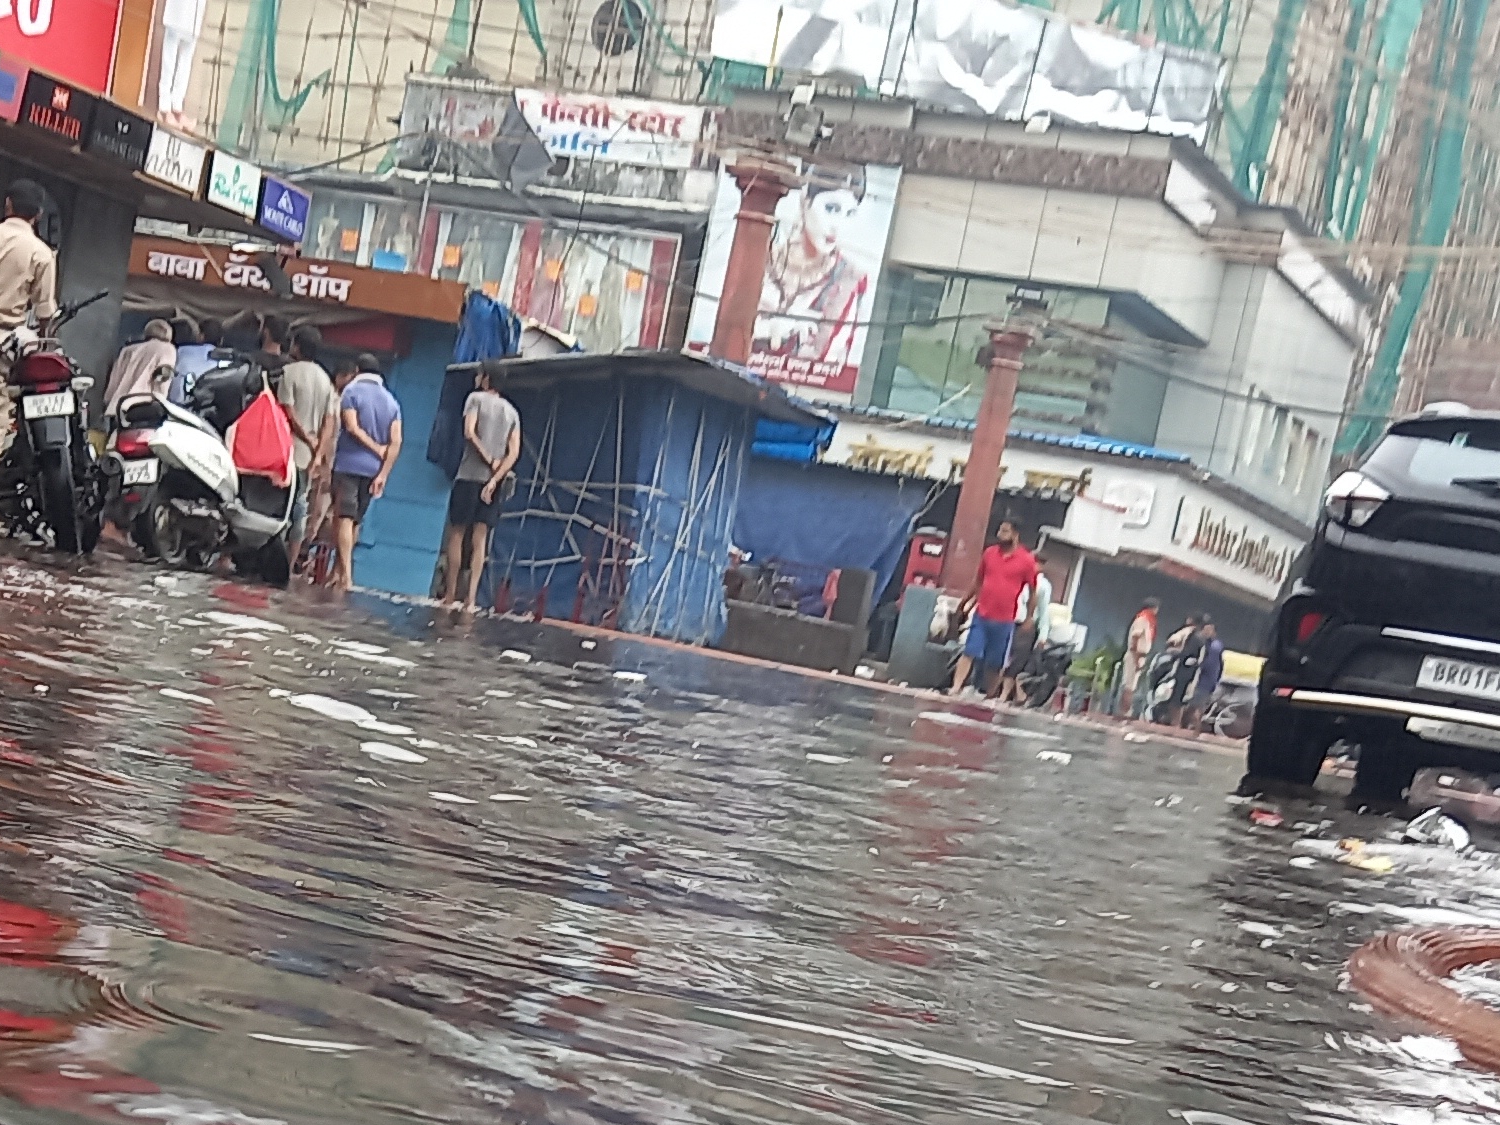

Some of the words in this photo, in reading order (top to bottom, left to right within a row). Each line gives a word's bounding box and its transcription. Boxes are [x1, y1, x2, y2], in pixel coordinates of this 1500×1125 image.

[28, 101, 81, 141] KILLER
[148, 251, 208, 281] बाबा
[292, 264, 353, 302] शॉप
[1432, 661, 1500, 692] BR01F
